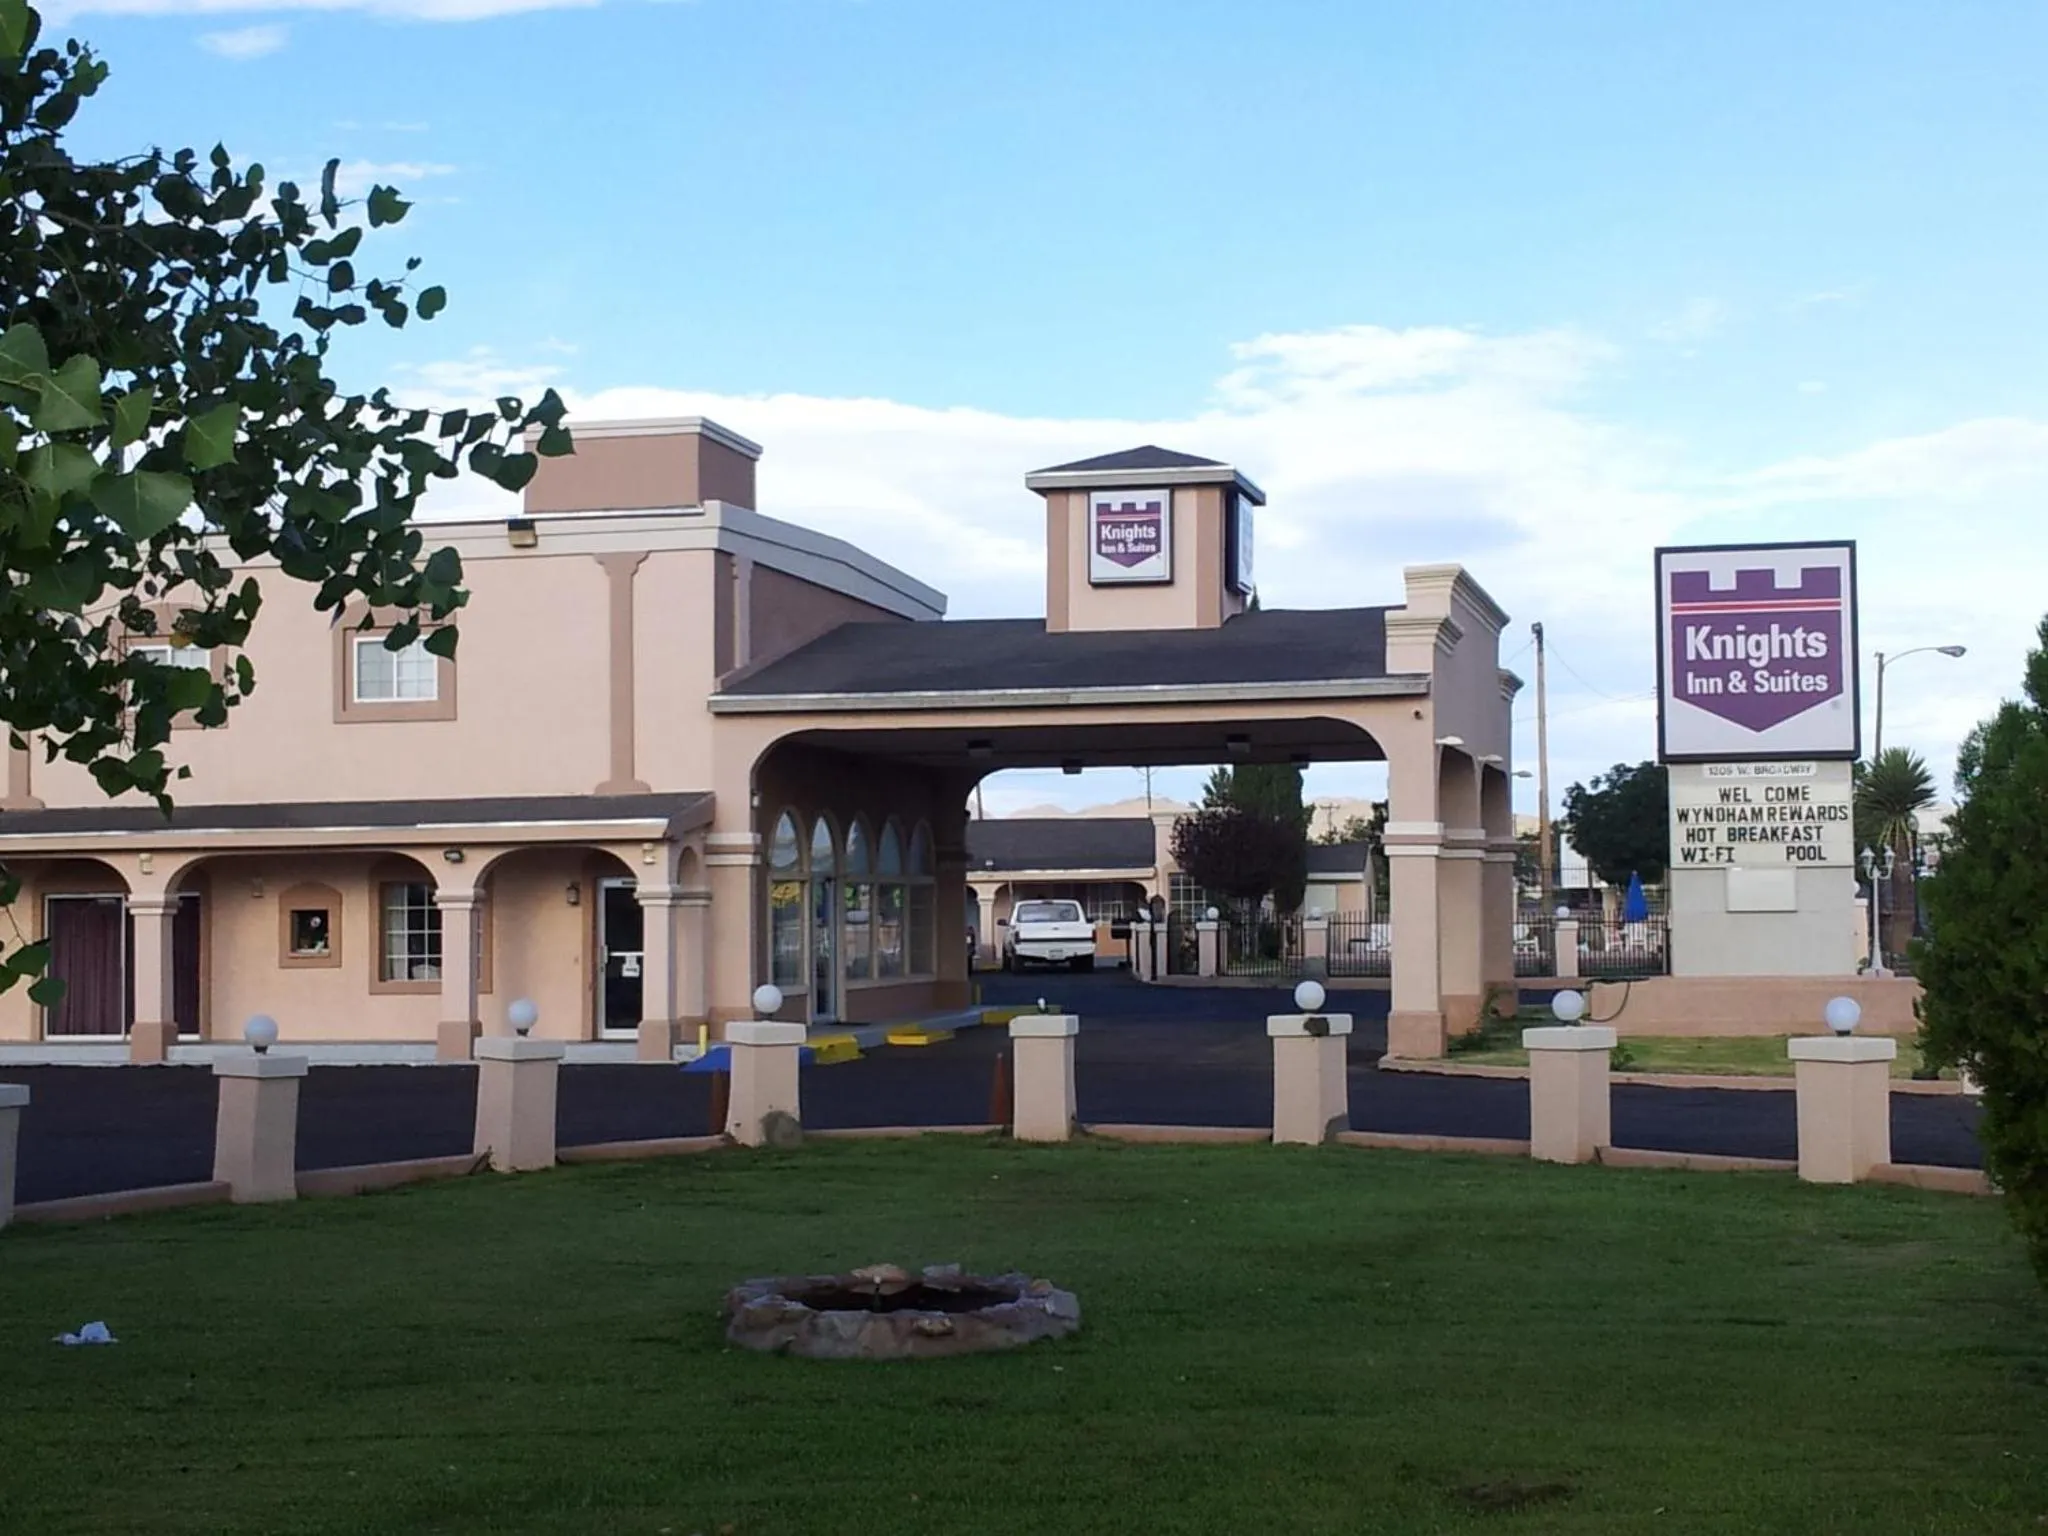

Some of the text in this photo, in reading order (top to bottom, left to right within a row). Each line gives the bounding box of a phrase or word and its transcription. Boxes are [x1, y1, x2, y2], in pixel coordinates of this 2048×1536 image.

[1101, 523, 1156, 542] Knights
[1101, 543, 1156, 553] Inn & Suites
[1686, 624, 1828, 668] Knights
[1687, 670, 1828, 694] Inn & Suites
[1765, 785, 1810, 801] COME
[1686, 825, 1823, 842] HOT BREAKFAST
[1681, 845, 1827, 863] WI-FI POOL
